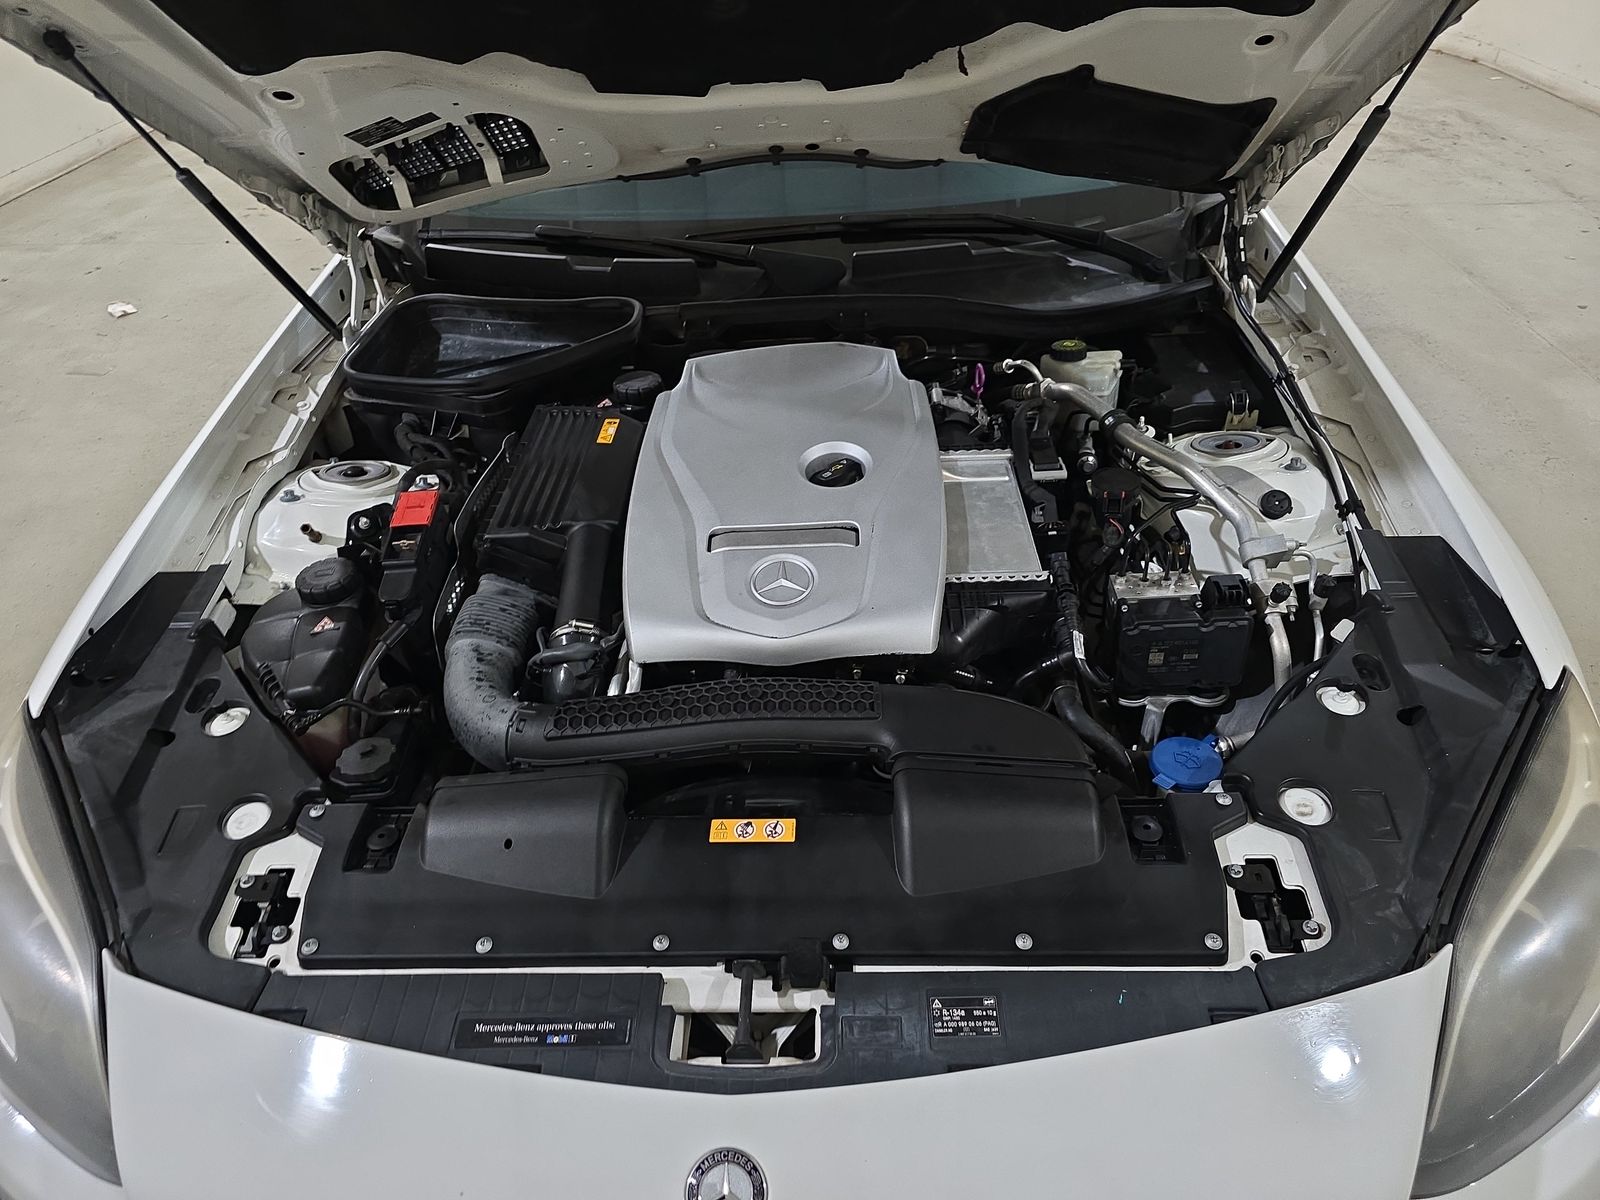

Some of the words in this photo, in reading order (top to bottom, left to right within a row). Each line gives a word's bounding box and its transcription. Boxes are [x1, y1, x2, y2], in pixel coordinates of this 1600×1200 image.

[942, 1008, 966, 1017] R-134a
[474, 1022, 536, 1033] Mercedes-Benz
[536, 1022, 573, 1033] approves
[700, 1150, 754, 1172] MERCEDES
